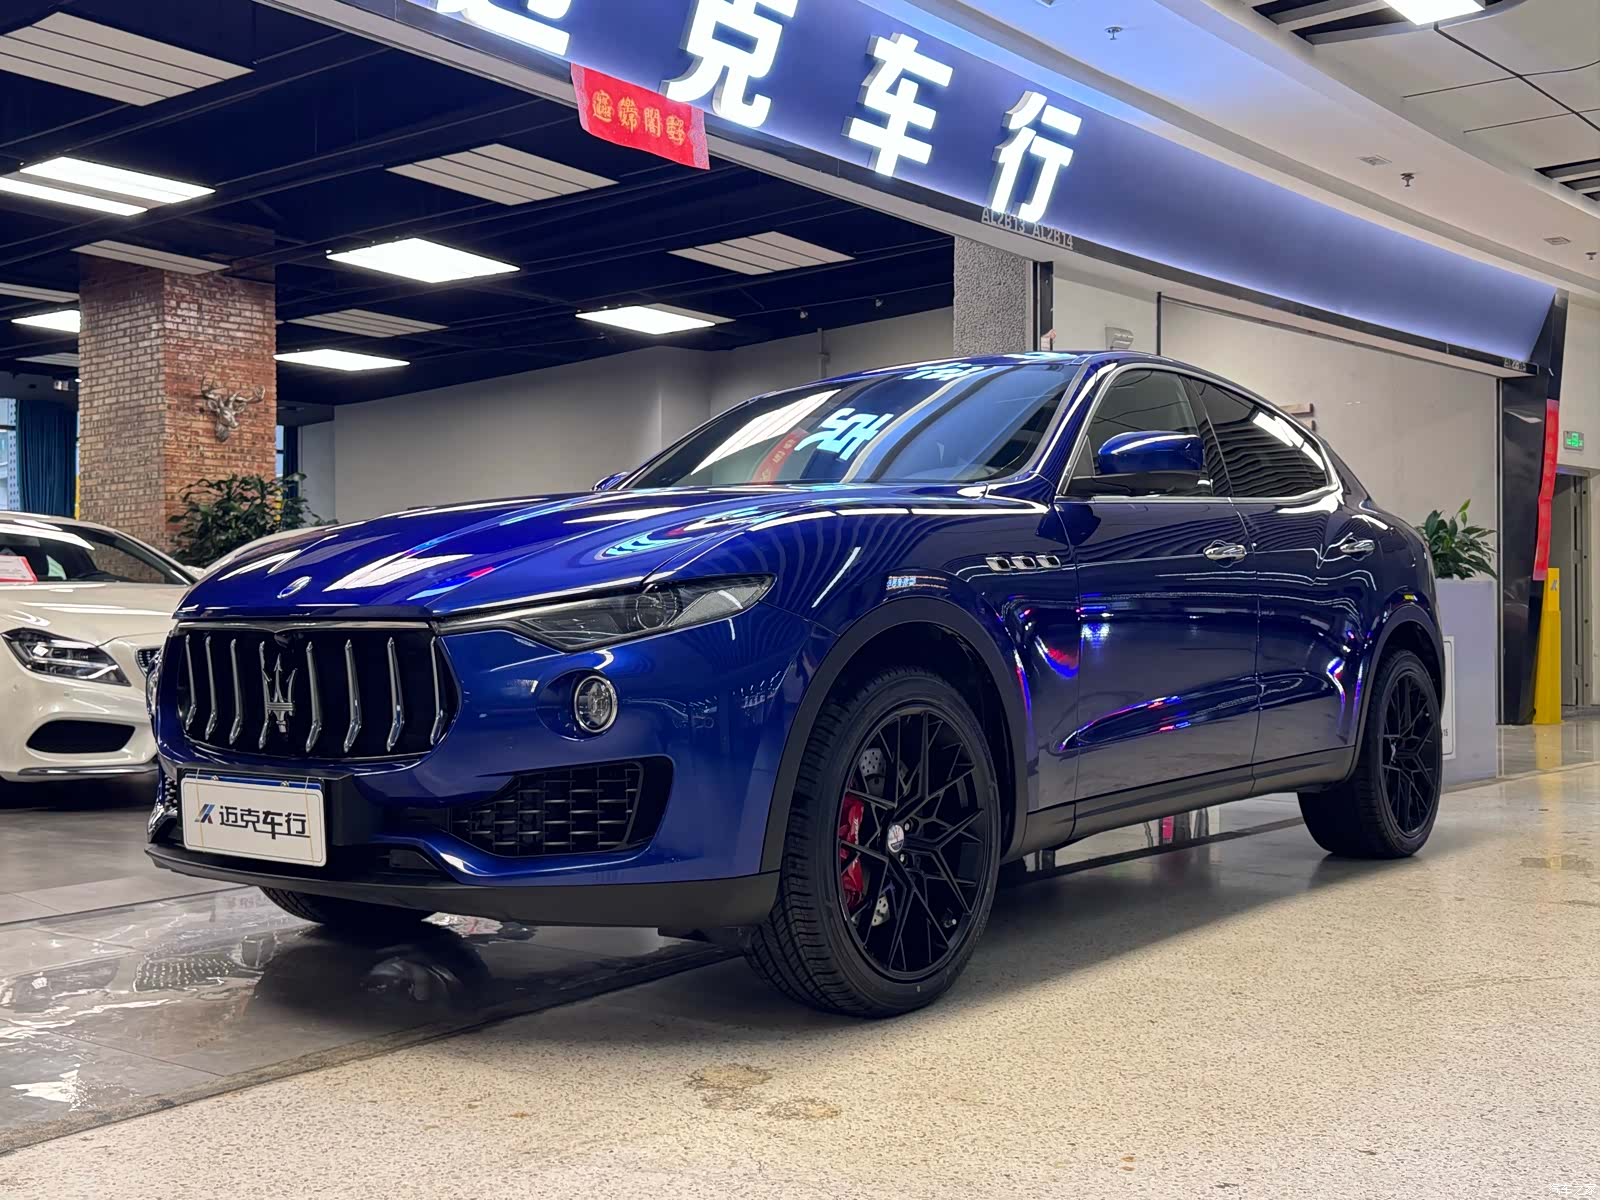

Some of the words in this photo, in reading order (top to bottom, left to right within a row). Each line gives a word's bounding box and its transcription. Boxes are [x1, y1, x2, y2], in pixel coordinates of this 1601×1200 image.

[981, 207, 1025, 233] AL2B13
[1032, 223, 1074, 250] AL2B14
[219, 805, 310, 840] 迈克车行
